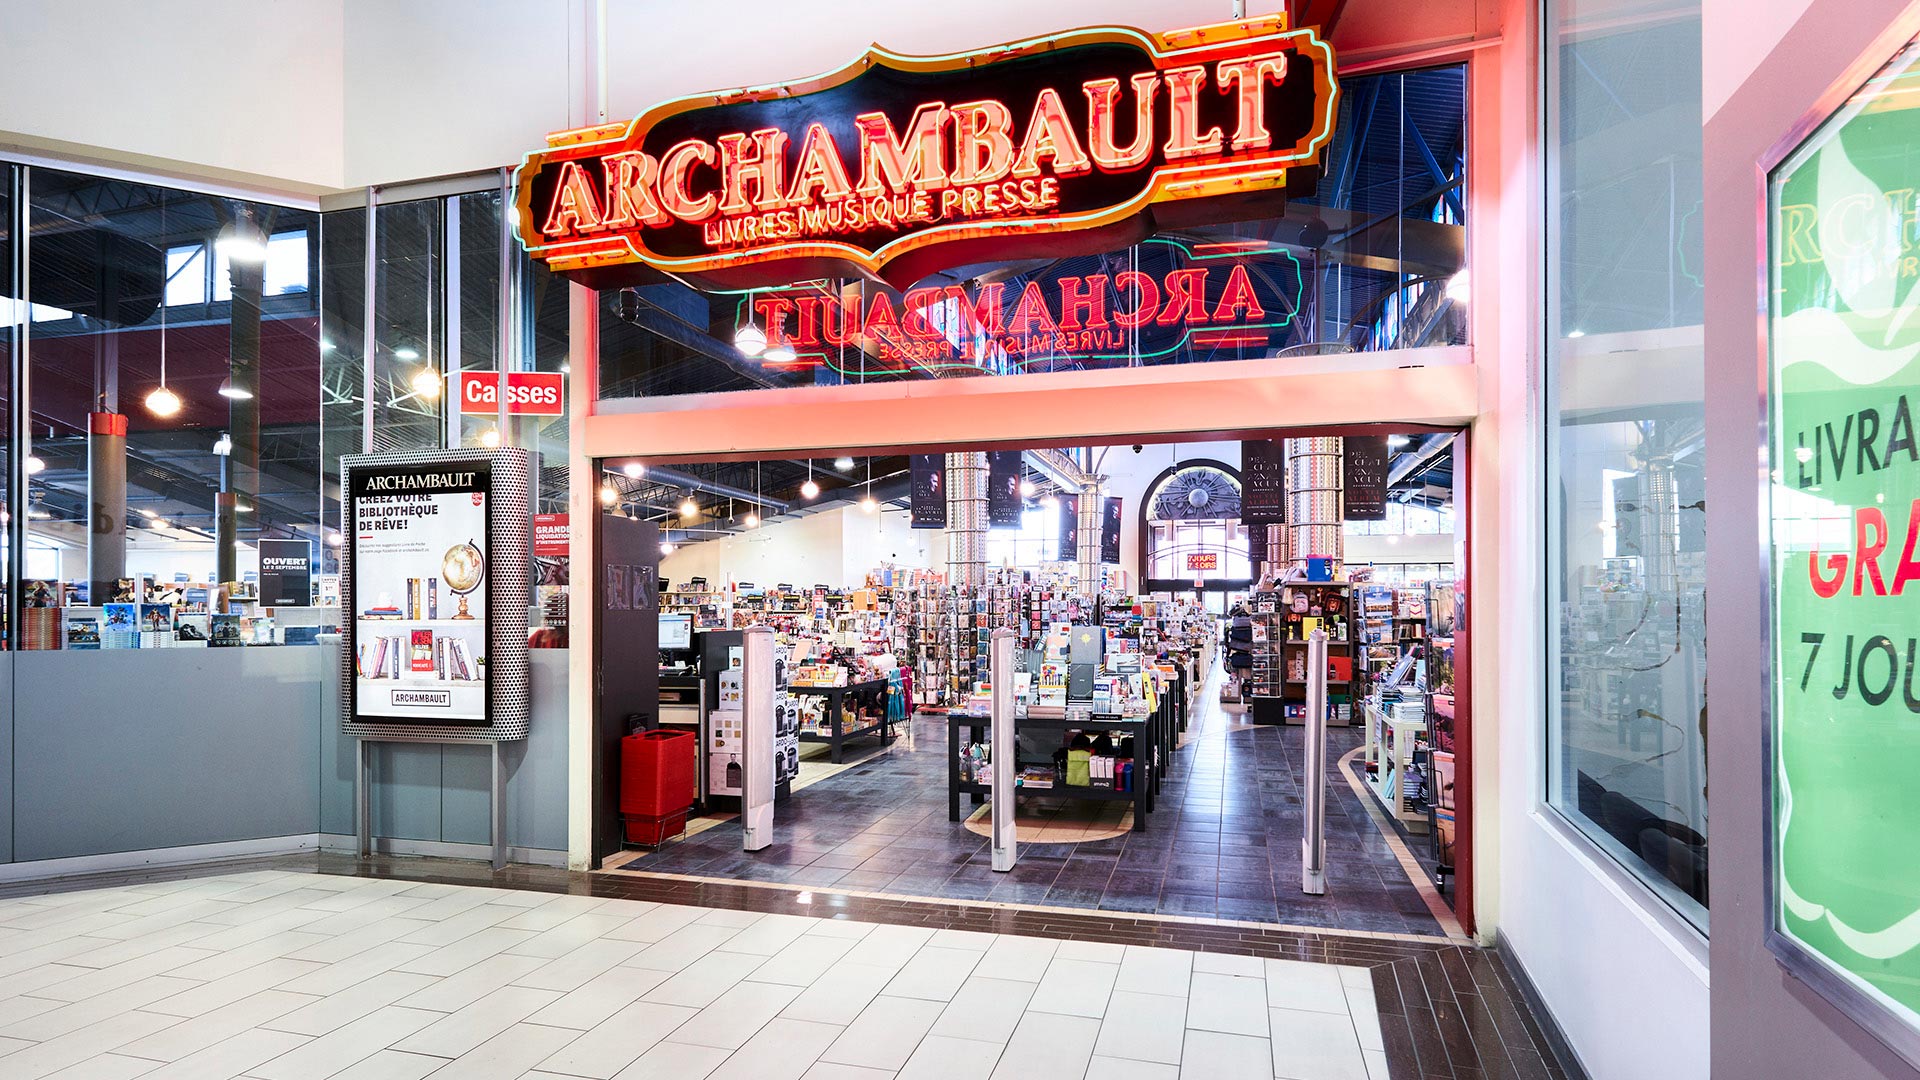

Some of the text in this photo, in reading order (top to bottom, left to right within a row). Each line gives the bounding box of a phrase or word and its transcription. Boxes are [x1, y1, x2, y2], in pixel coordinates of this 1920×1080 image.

[543, 51, 1287, 234] ARCHAMBAULT
[704, 177, 1060, 245] LIVRES MUSIQUE PRESSE
[1798, 394, 1920, 489] LIVRA
[365, 472, 476, 491] ARCHAMBAULT
[396, 493, 432, 503] VOTRE
[359, 503, 438, 518] BIBLIOTHÈQUE
[359, 521, 373, 531] DE
[536, 526, 569, 534] GRANDE
[263, 557, 307, 565] OUVERT
[1801, 632, 1825, 694] 7
[395, 693, 447, 704] ARCHAMBAULT
